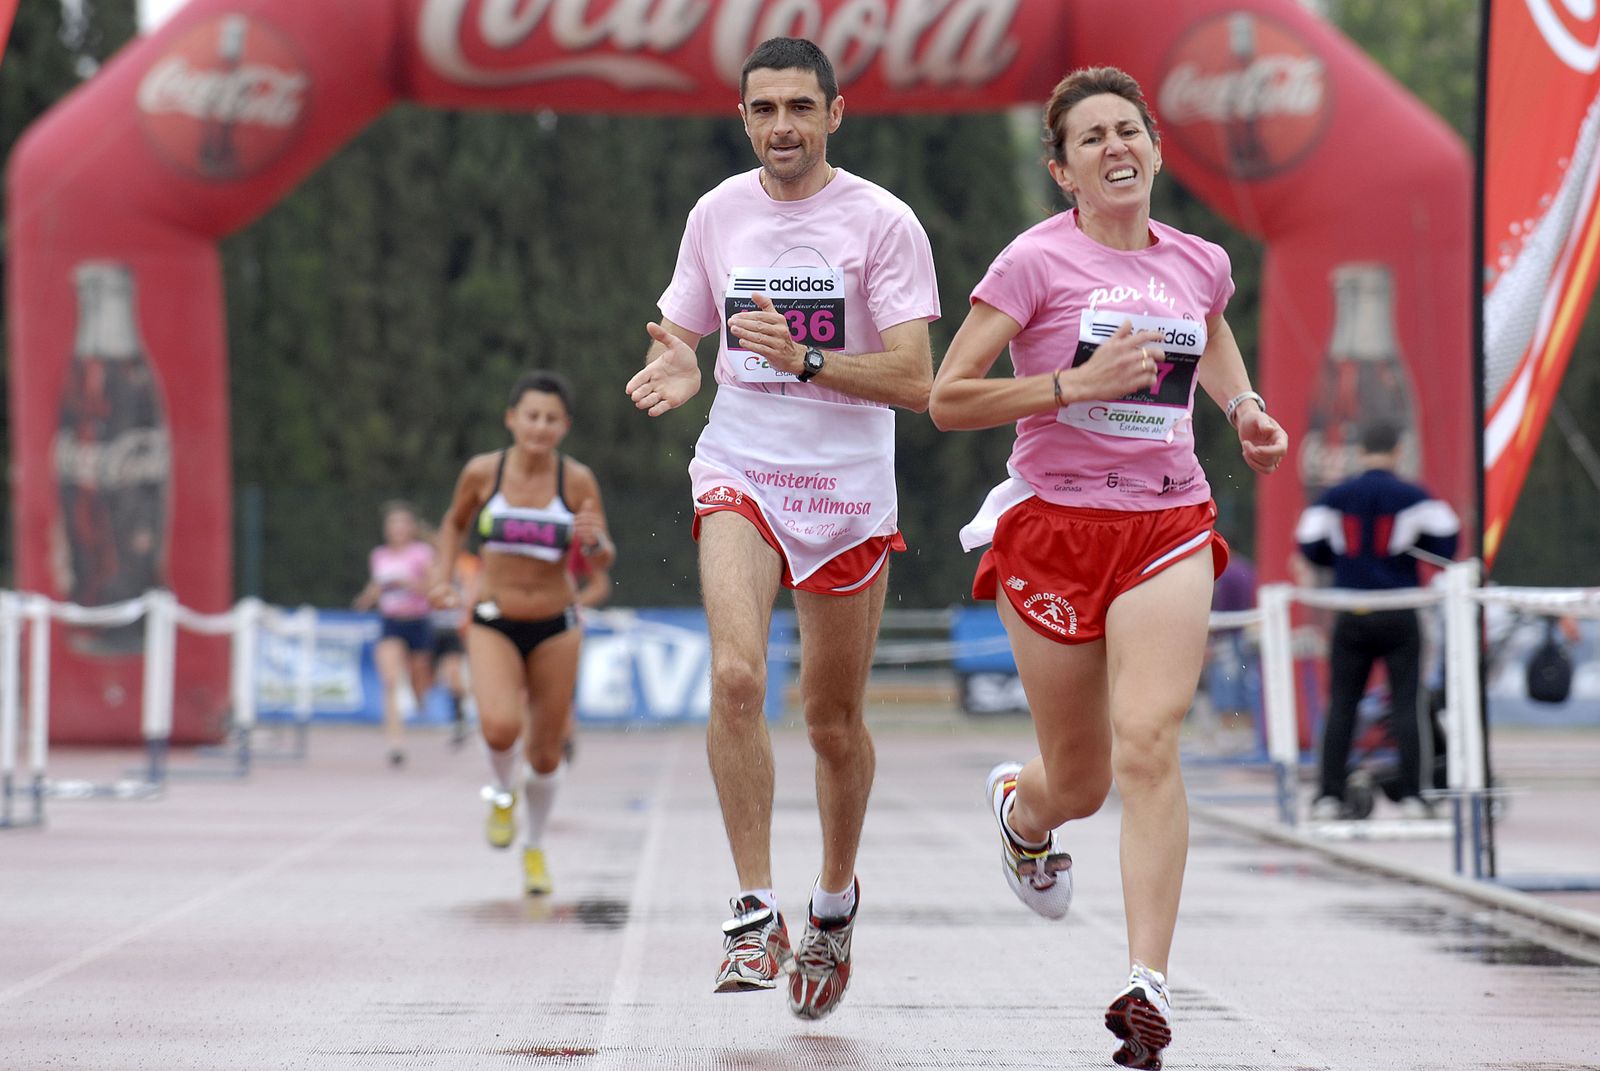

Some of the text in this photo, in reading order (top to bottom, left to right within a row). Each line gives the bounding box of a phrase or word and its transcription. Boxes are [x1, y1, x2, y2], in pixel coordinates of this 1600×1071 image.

[769, 277, 834, 292] adidas
[1087, 284, 1143, 313] por
[783, 497, 871, 515] La Mimosa
[503, 519, 557, 545] 904
[1023, 592, 1078, 635] CLUB DE ATLETISMO
[1027, 609, 1067, 635] ALBOLOTE
